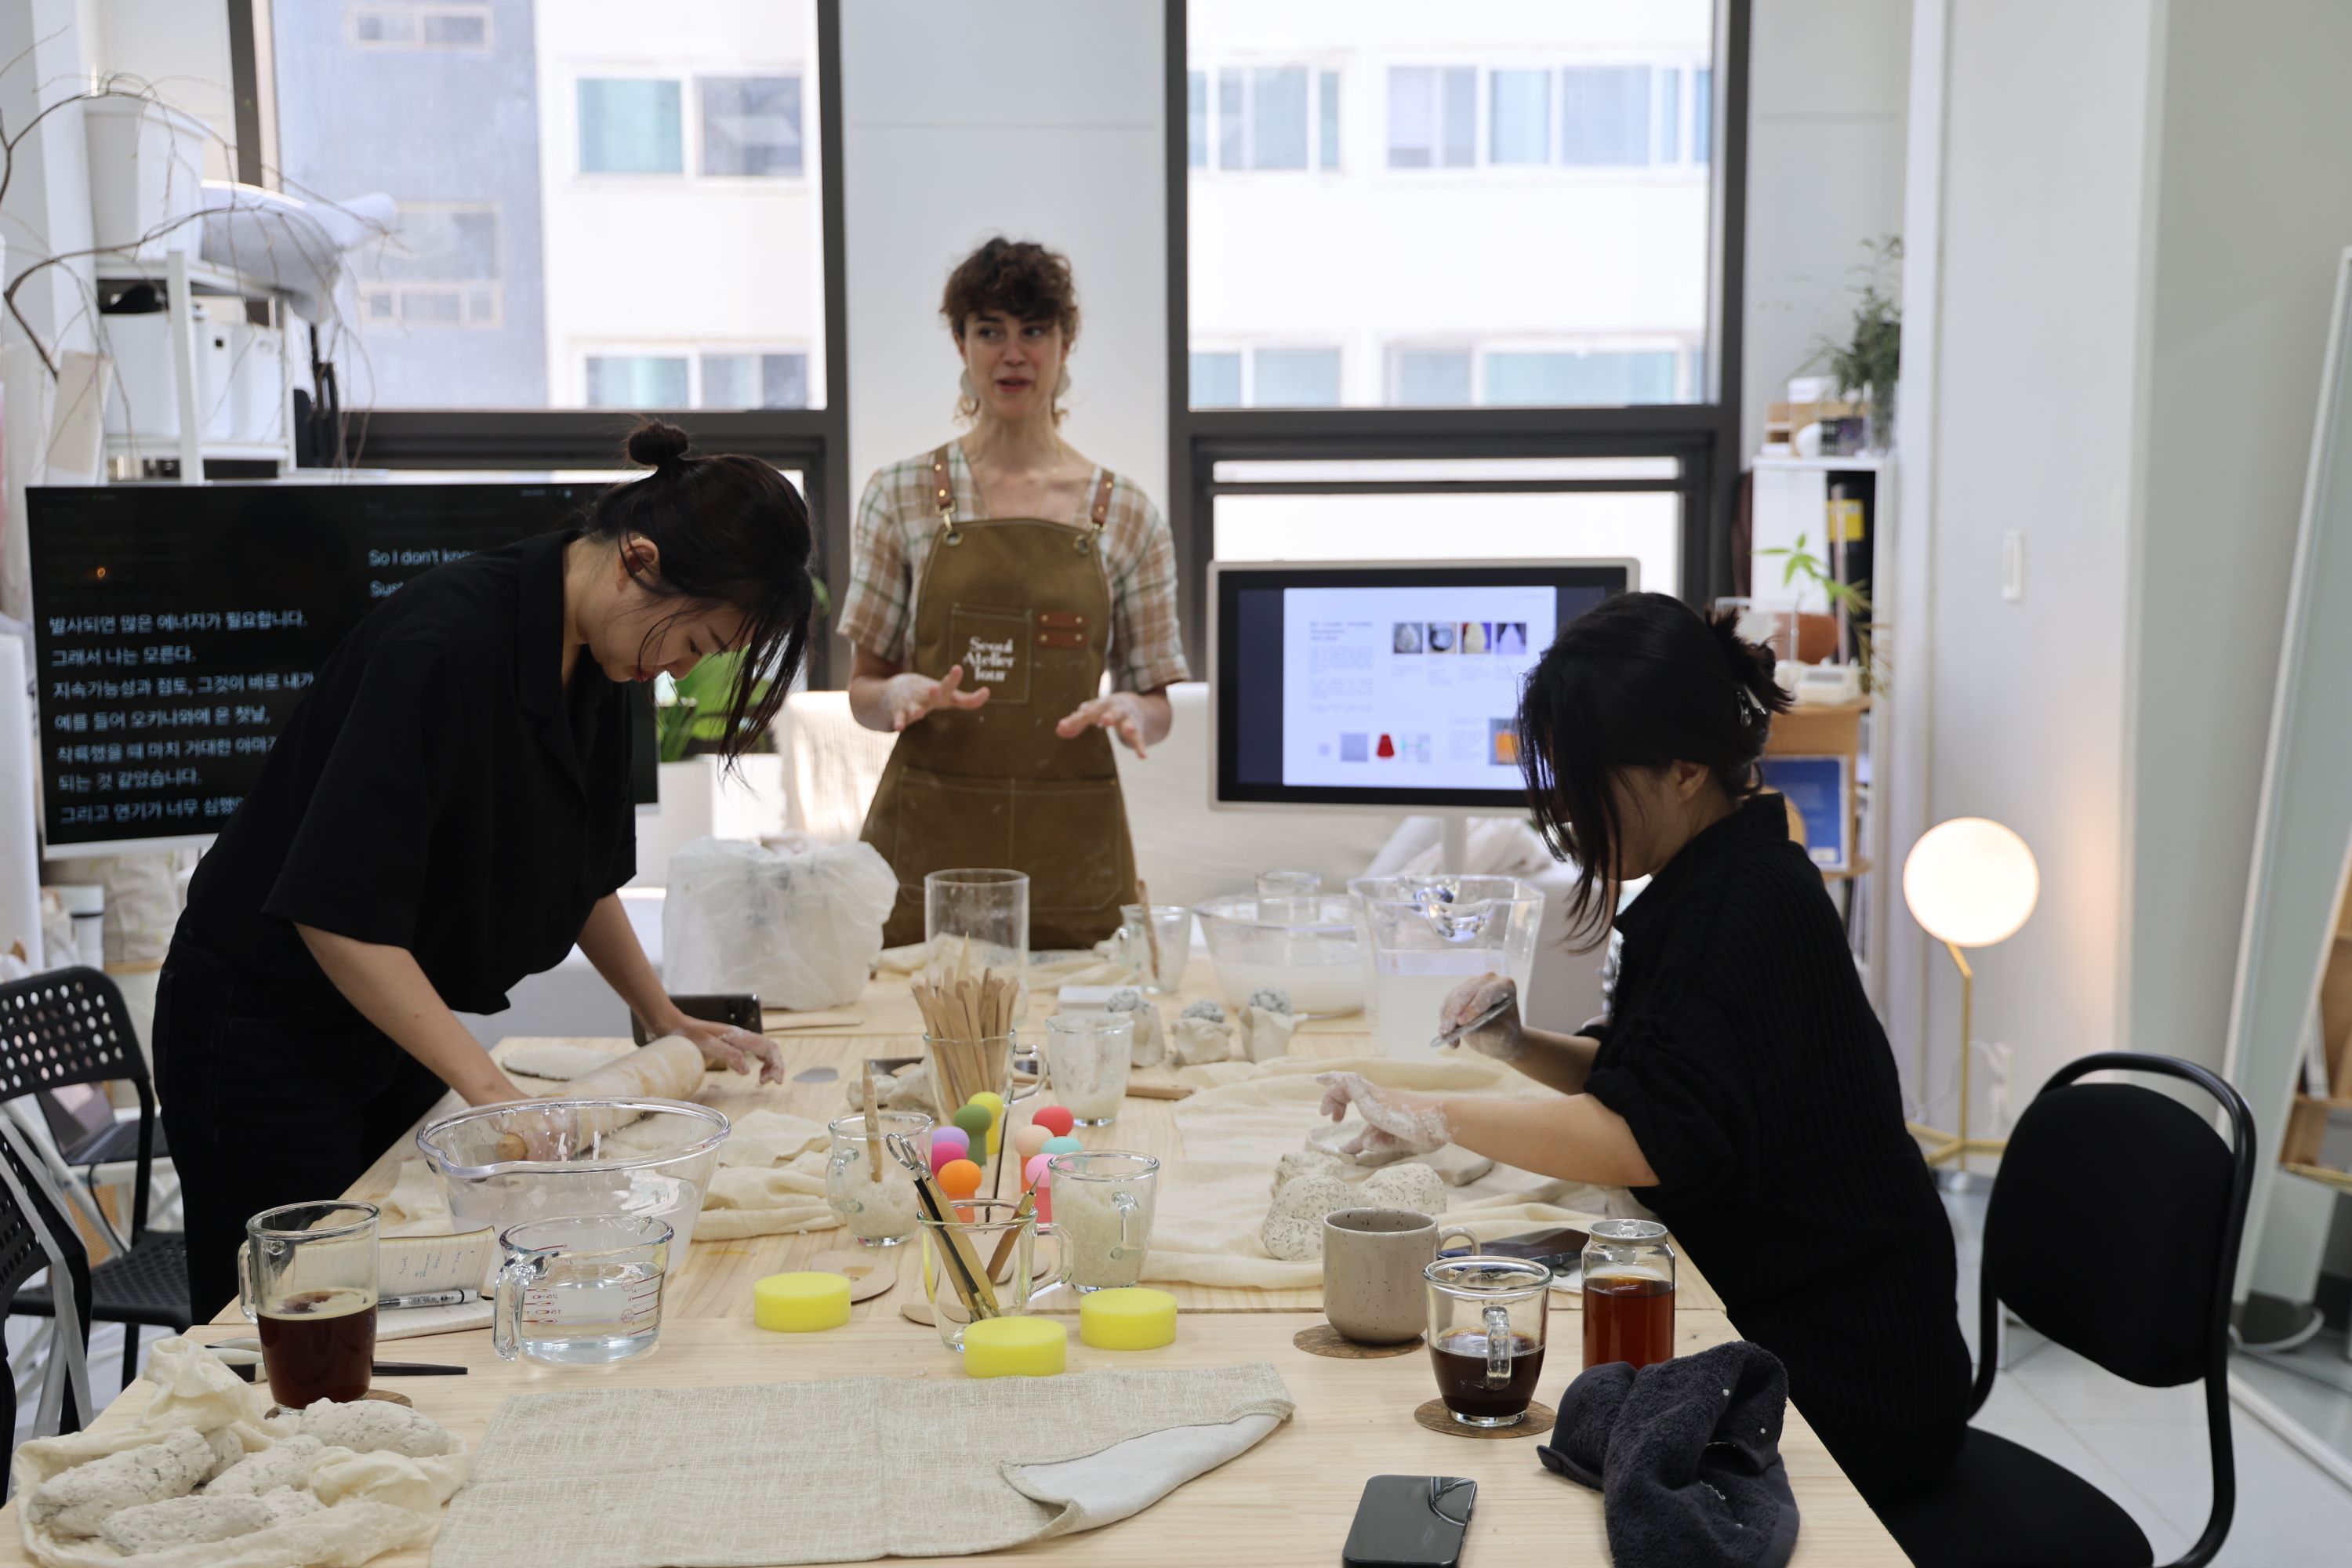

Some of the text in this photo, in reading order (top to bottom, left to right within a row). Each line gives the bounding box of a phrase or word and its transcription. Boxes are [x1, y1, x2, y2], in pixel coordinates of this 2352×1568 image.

[368, 549, 390, 566] So
[401, 550, 439, 564] don't
[120, 614, 153, 633] 많은
[157, 612, 220, 632] 에너지가
[226, 609, 308, 631] 필요합니다.
[51, 644, 196, 667] 그래서 나는 모른다.
[969, 636, 1013, 653] Seoul
[963, 652, 1014, 667] Atelier
[973, 666, 1007, 682] Tour
[53, 679, 151, 700] 지속가능성과
[157, 677, 193, 698] 점토,
[198, 674, 245, 694] 그것이
[248, 673, 279, 692] 바로
[54, 713, 88, 732] 예를
[93, 710, 126, 731] 들어
[130, 707, 211, 728] 오키나와에
[235, 705, 270, 725] 첫날,
[184, 736, 231, 758] 거대한
[60, 804, 109, 823] 그리고
[114, 800, 162, 822] 연기가
[166, 797, 198, 818] 너무
